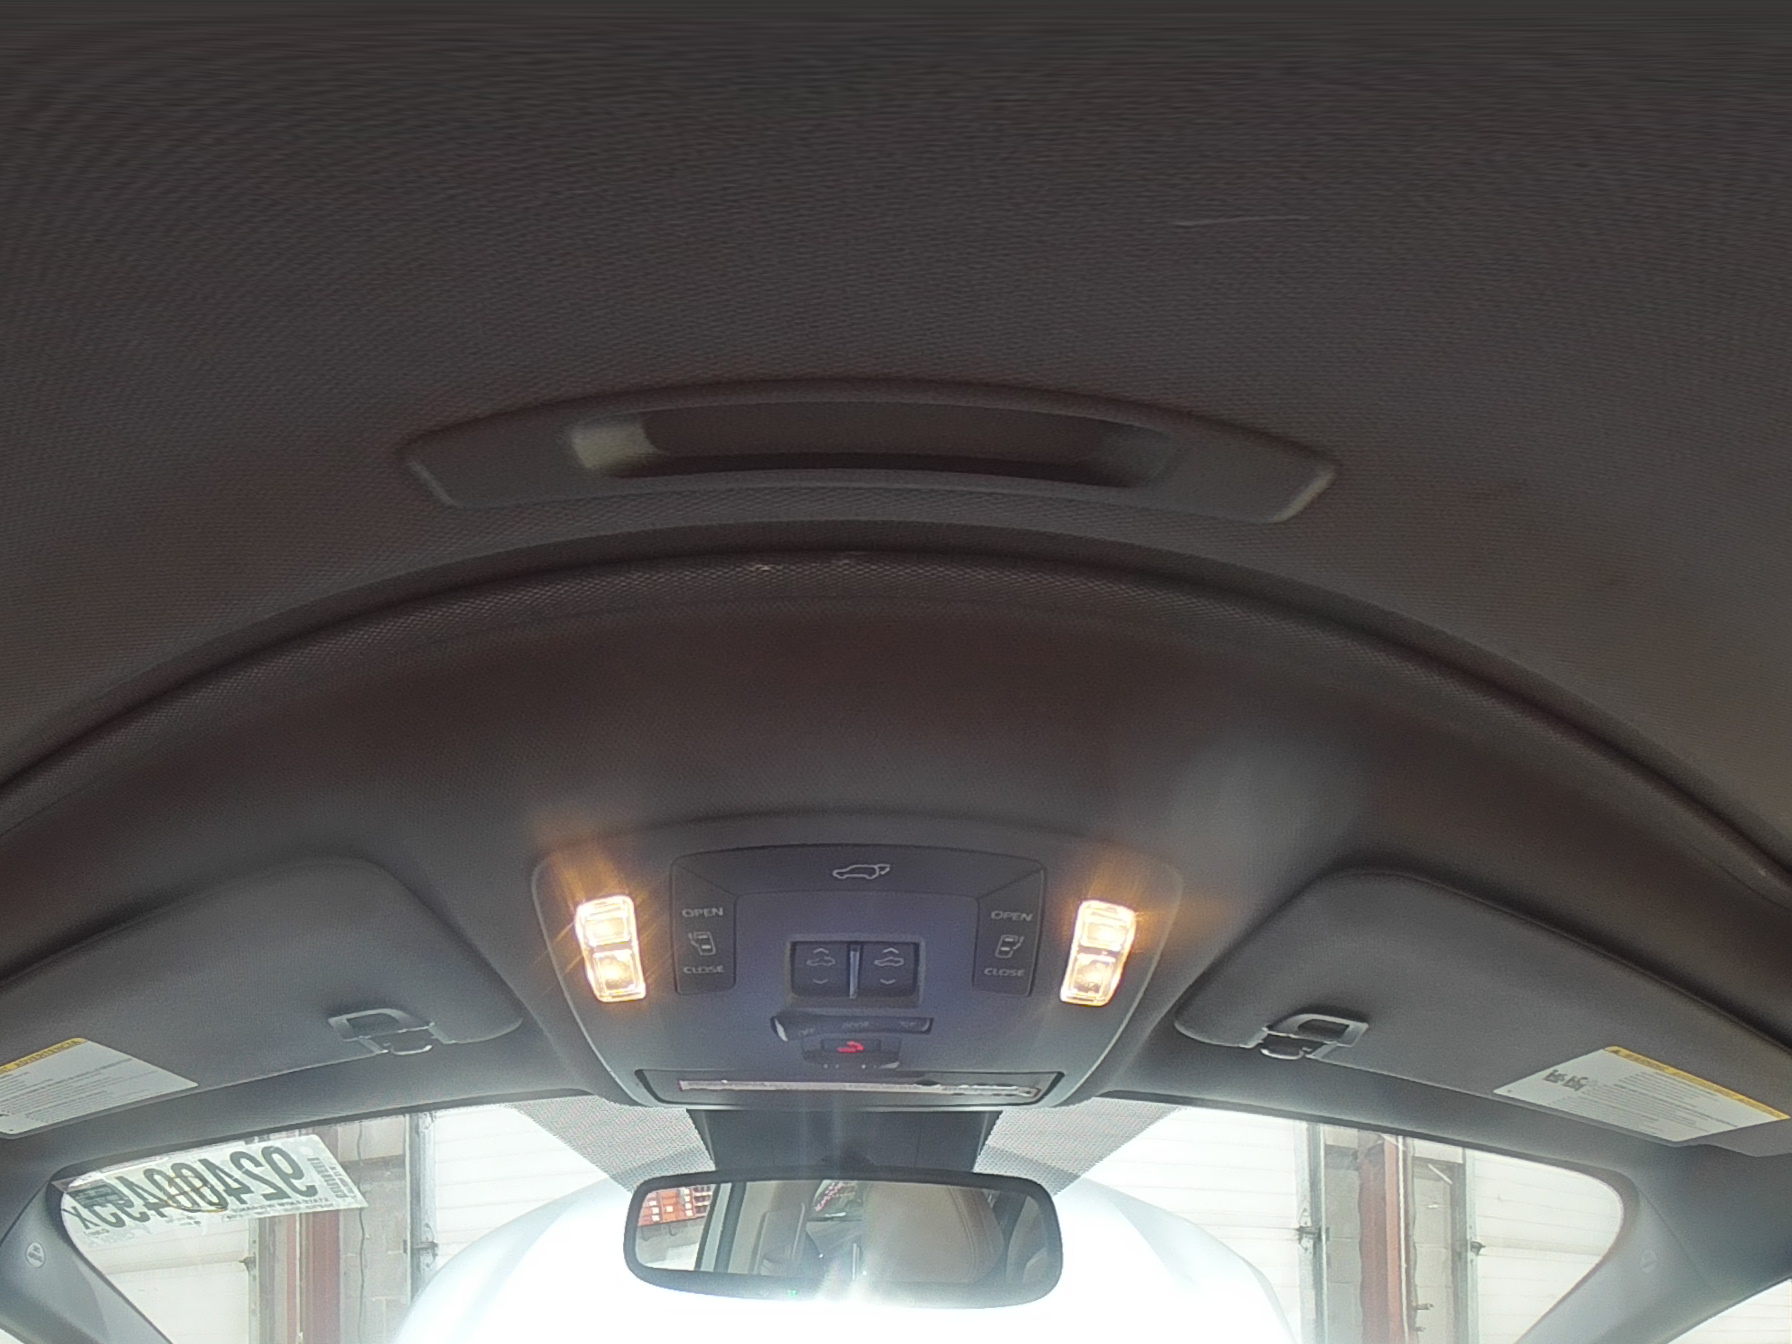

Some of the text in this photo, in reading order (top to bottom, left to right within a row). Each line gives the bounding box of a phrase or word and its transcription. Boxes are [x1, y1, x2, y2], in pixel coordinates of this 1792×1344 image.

[682, 907, 724, 918] OPEN
[990, 910, 1033, 922] OPEN
[683, 965, 724, 975] CLOSE
[984, 967, 1025, 977] CLOSE
